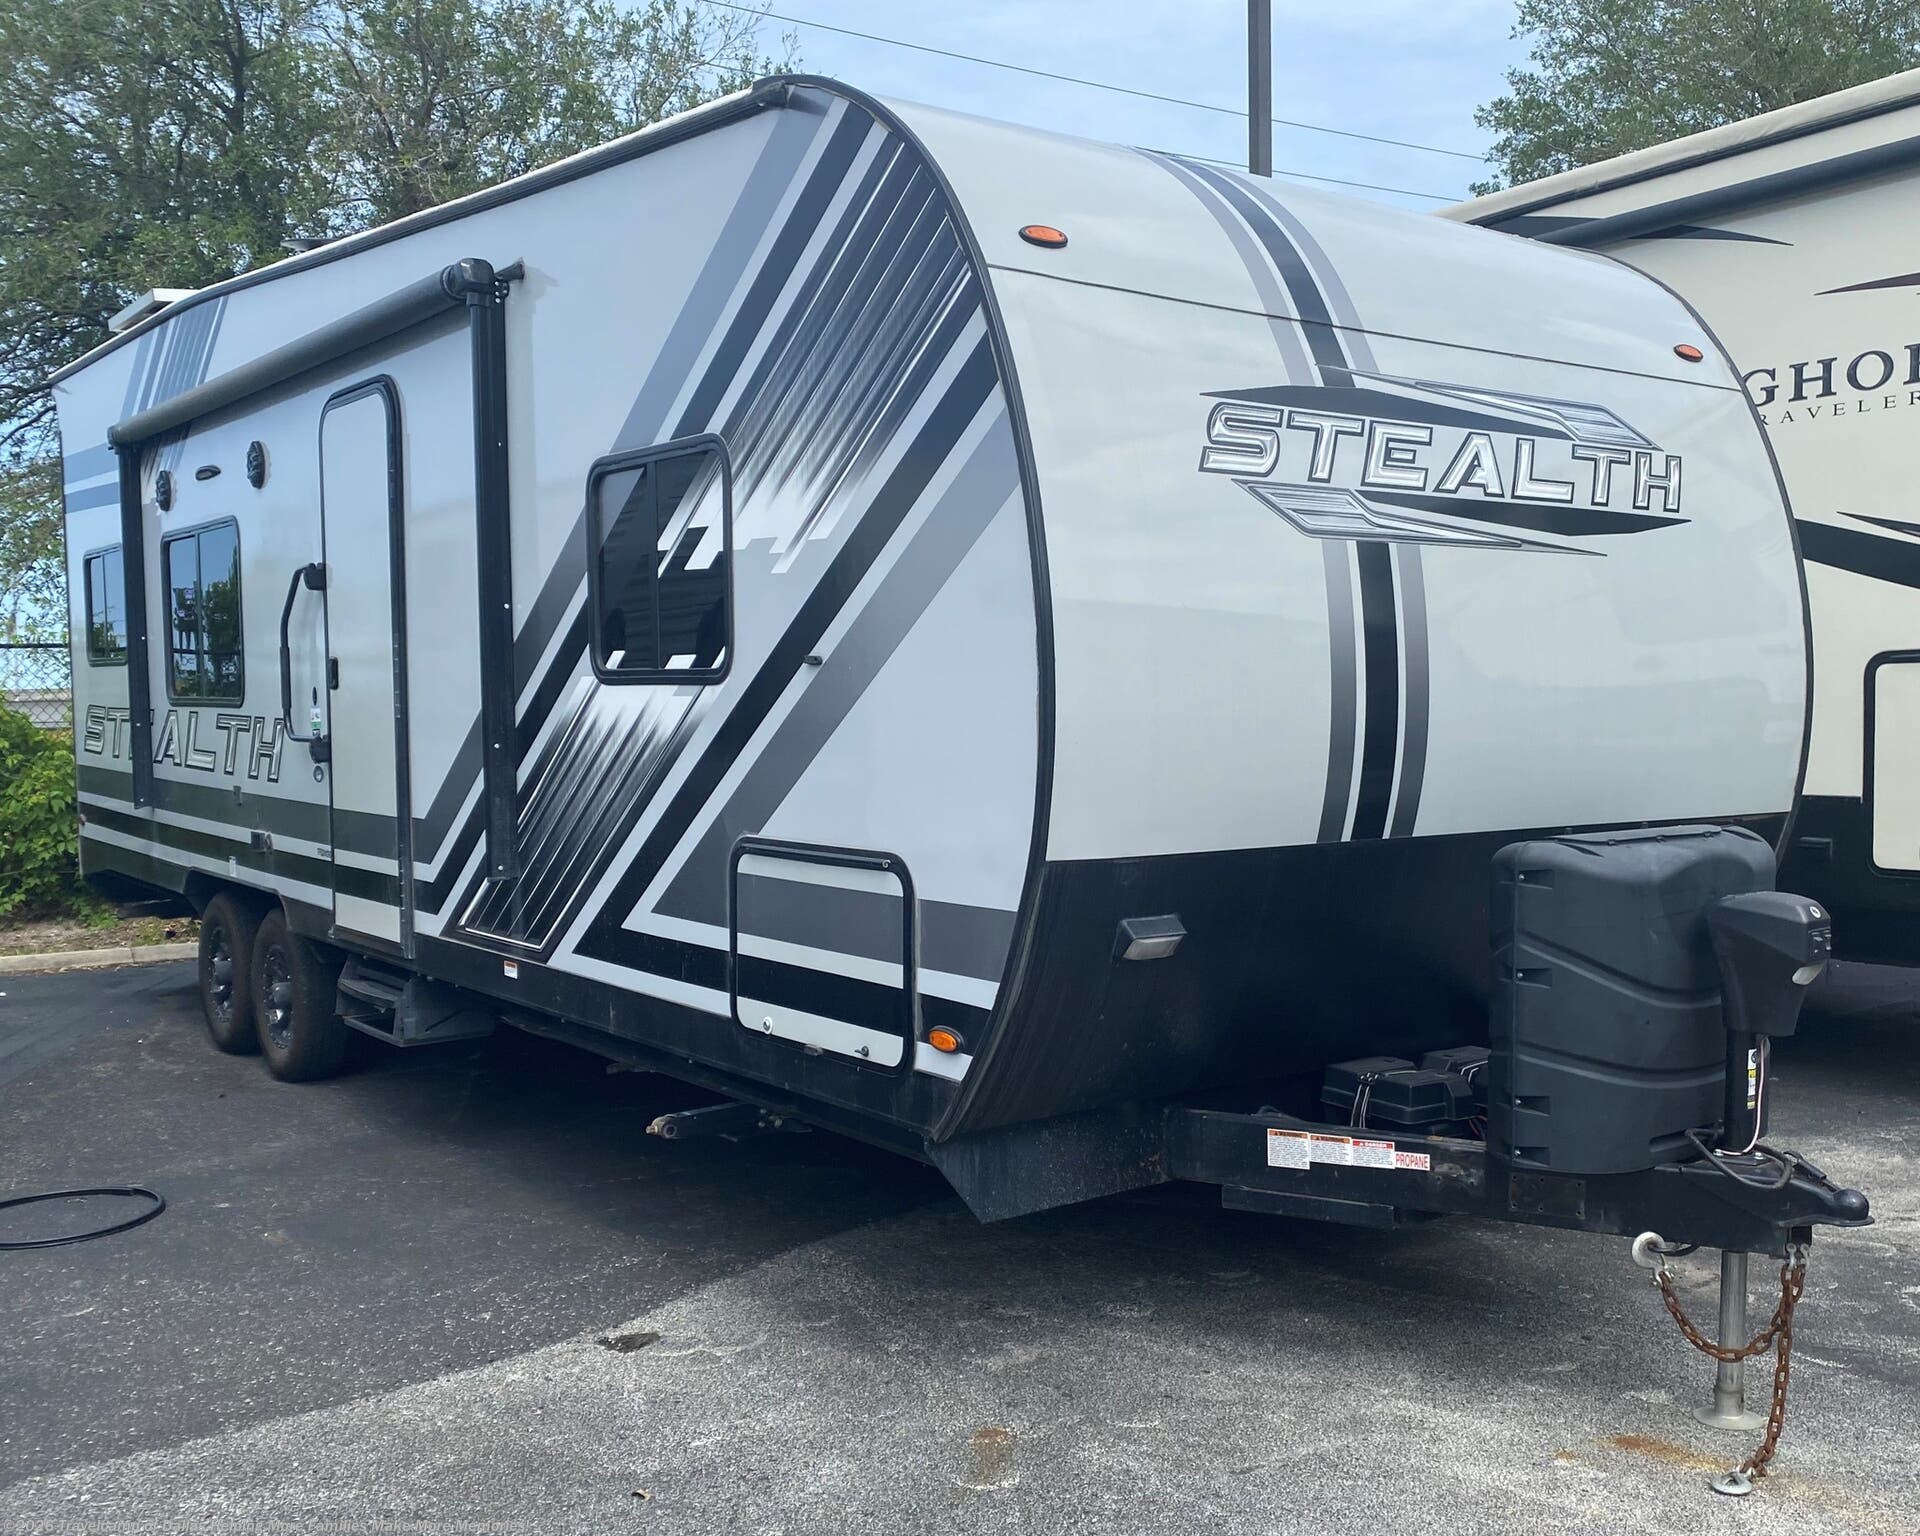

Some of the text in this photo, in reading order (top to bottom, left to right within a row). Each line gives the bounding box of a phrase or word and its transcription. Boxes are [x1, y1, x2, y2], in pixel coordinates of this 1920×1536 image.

[1198, 400, 1682, 513] STEALTH
[84, 704, 284, 783] STALTH
[1395, 1153, 1429, 1169] PROPANE
